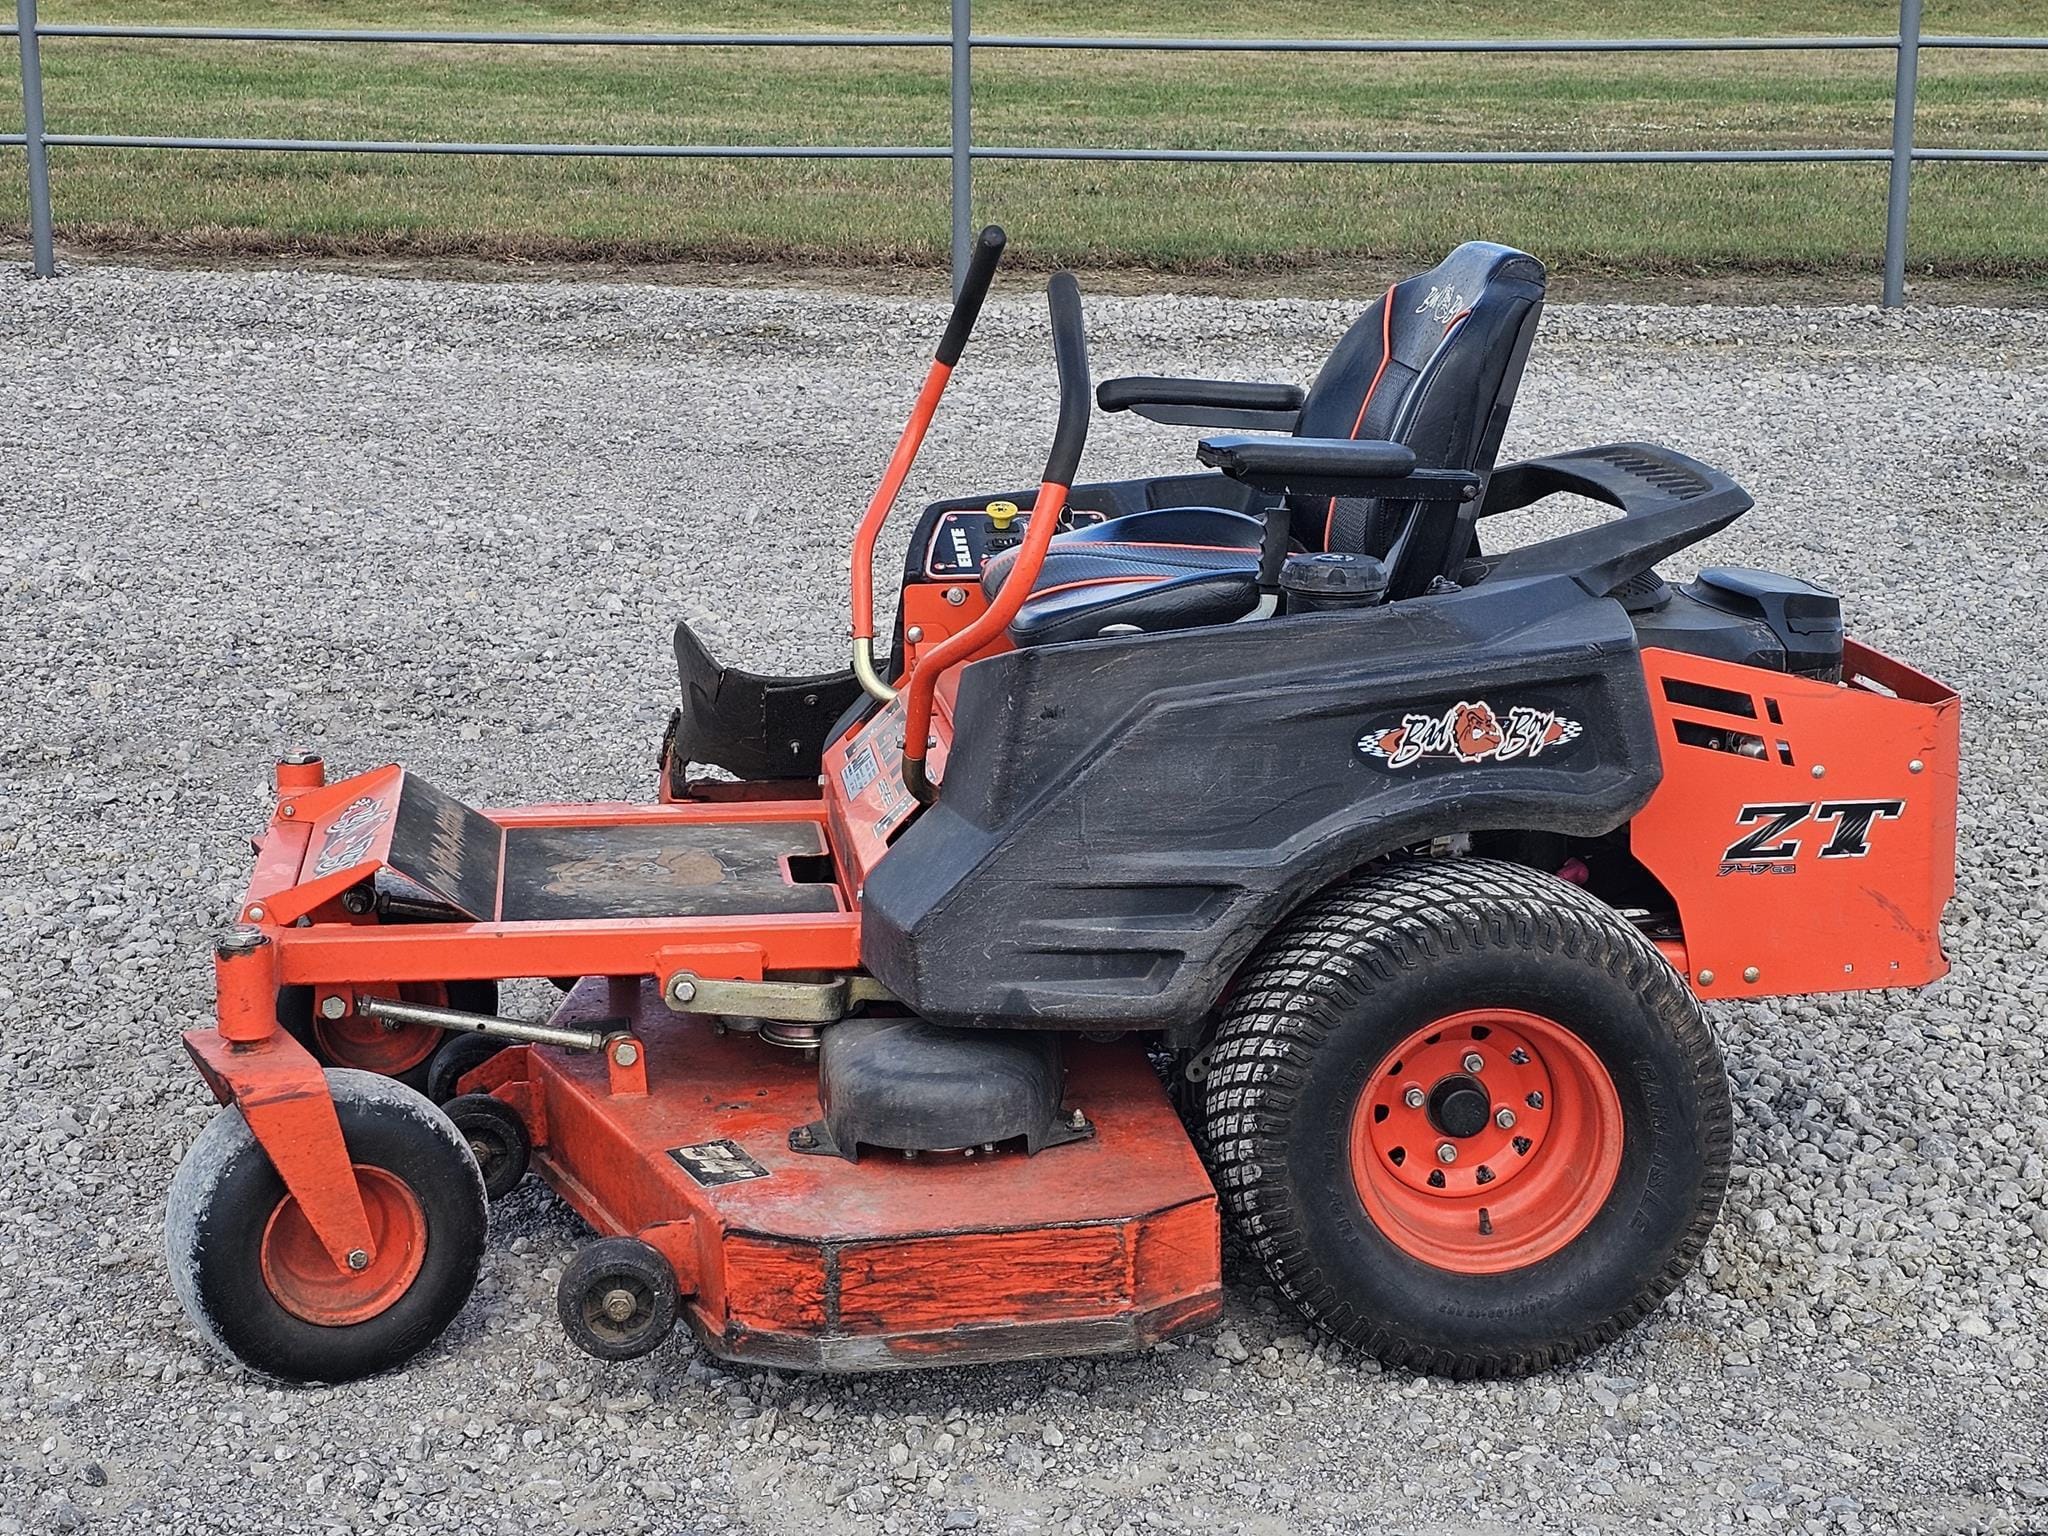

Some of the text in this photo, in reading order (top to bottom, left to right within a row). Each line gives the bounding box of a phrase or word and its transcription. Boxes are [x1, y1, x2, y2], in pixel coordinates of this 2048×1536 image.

[950, 528, 973, 568] ELITE
[1720, 798, 1908, 862] ZT
[1631, 1060, 1667, 1234] CARLISLE
